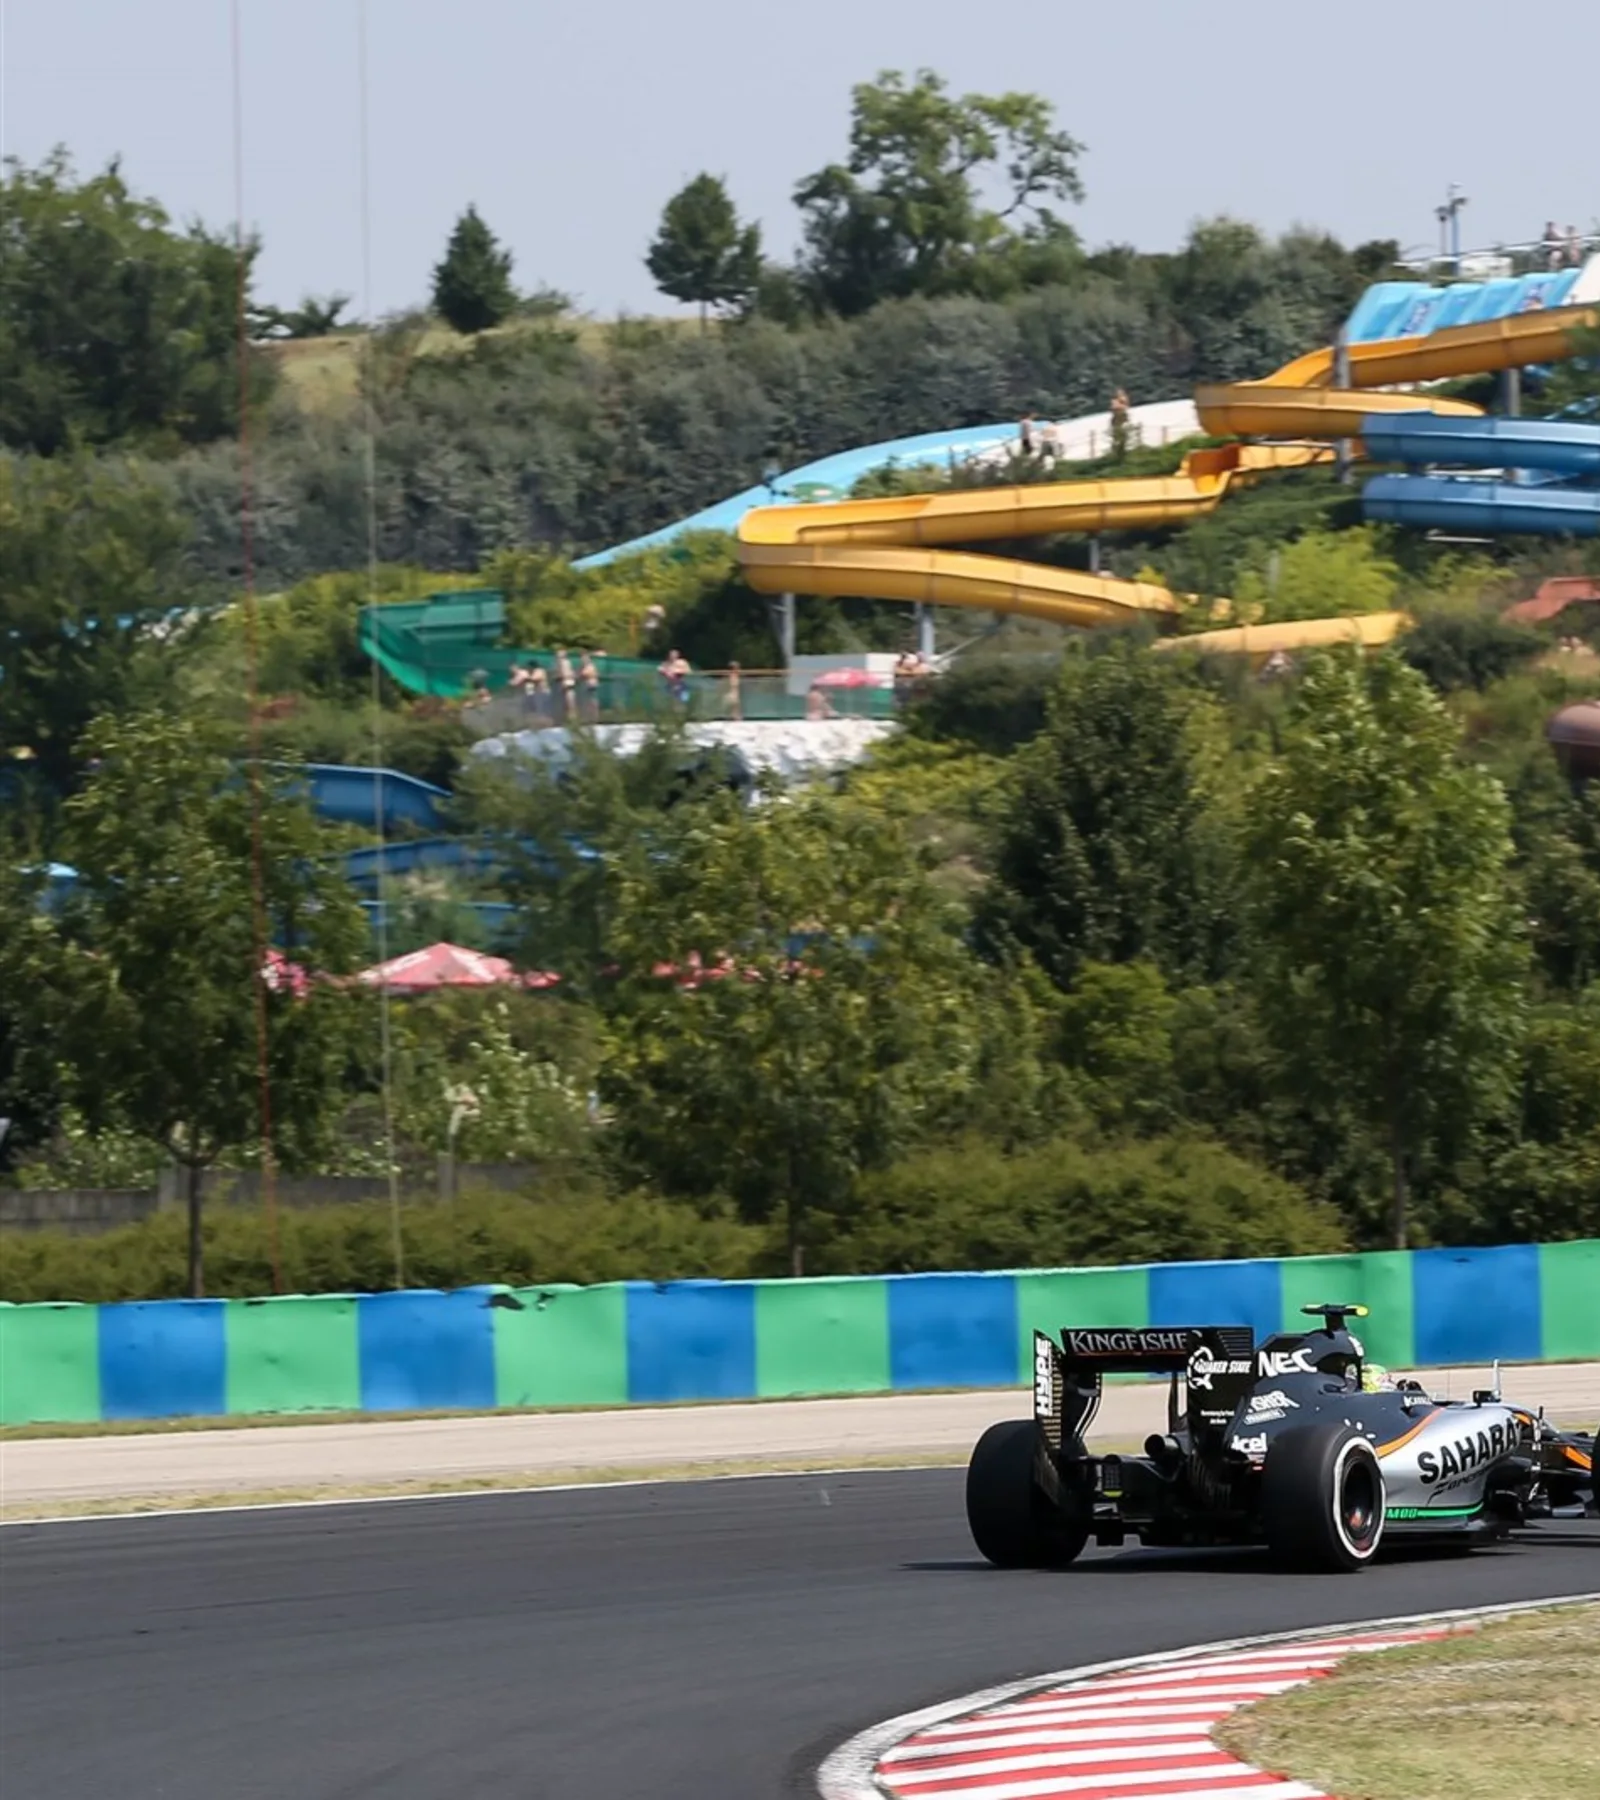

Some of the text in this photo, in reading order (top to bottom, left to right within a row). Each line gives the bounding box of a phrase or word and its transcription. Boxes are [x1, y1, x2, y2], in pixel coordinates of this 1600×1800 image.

[1068, 1331, 1187, 1353] KINGFISHE
[1258, 1348, 1318, 1377] NEC
[1035, 1337, 1050, 1416] HYPE
[1417, 1417, 1520, 1484] SAHARA
